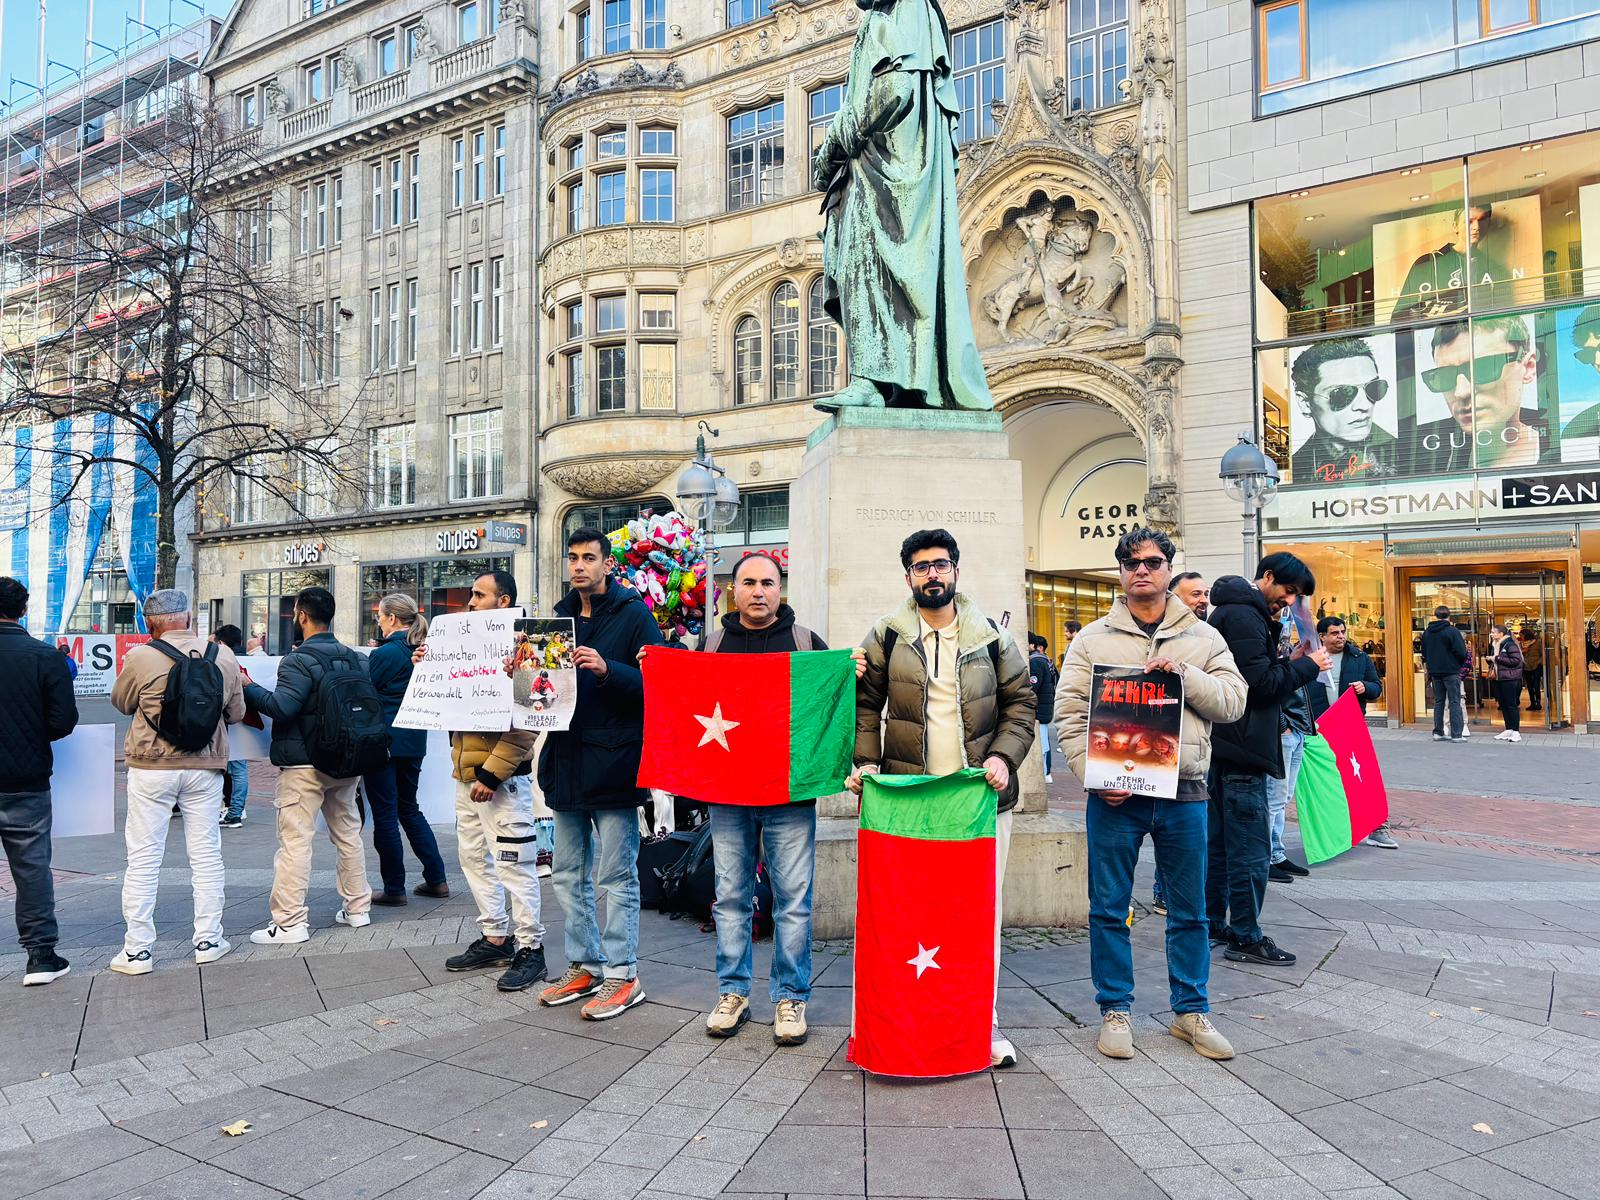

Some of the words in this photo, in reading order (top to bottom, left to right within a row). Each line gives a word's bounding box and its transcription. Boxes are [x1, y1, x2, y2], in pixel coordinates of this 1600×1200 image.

[1422, 426, 1533, 451] GUCC
[1312, 488, 1498, 519] HORSTMANN
[856, 508, 915, 521] FRIEDRICH
[917, 509, 944, 522] VON
[946, 510, 998, 523] SCHILLER
[1078, 504, 1146, 521] GEOR
[436, 527, 479, 555] snipes
[494, 526, 521, 540] snipes
[284, 543, 320, 567] snipes
[458, 619, 471, 635] ist
[485, 618, 505, 632] Vom
[430, 670, 443, 683] ein
[1101, 679, 1166, 705] ZEHRI
[1103, 781, 1157, 792] UNDERSIEGE
[1116, 776, 1145, 784] #ZEHRI
